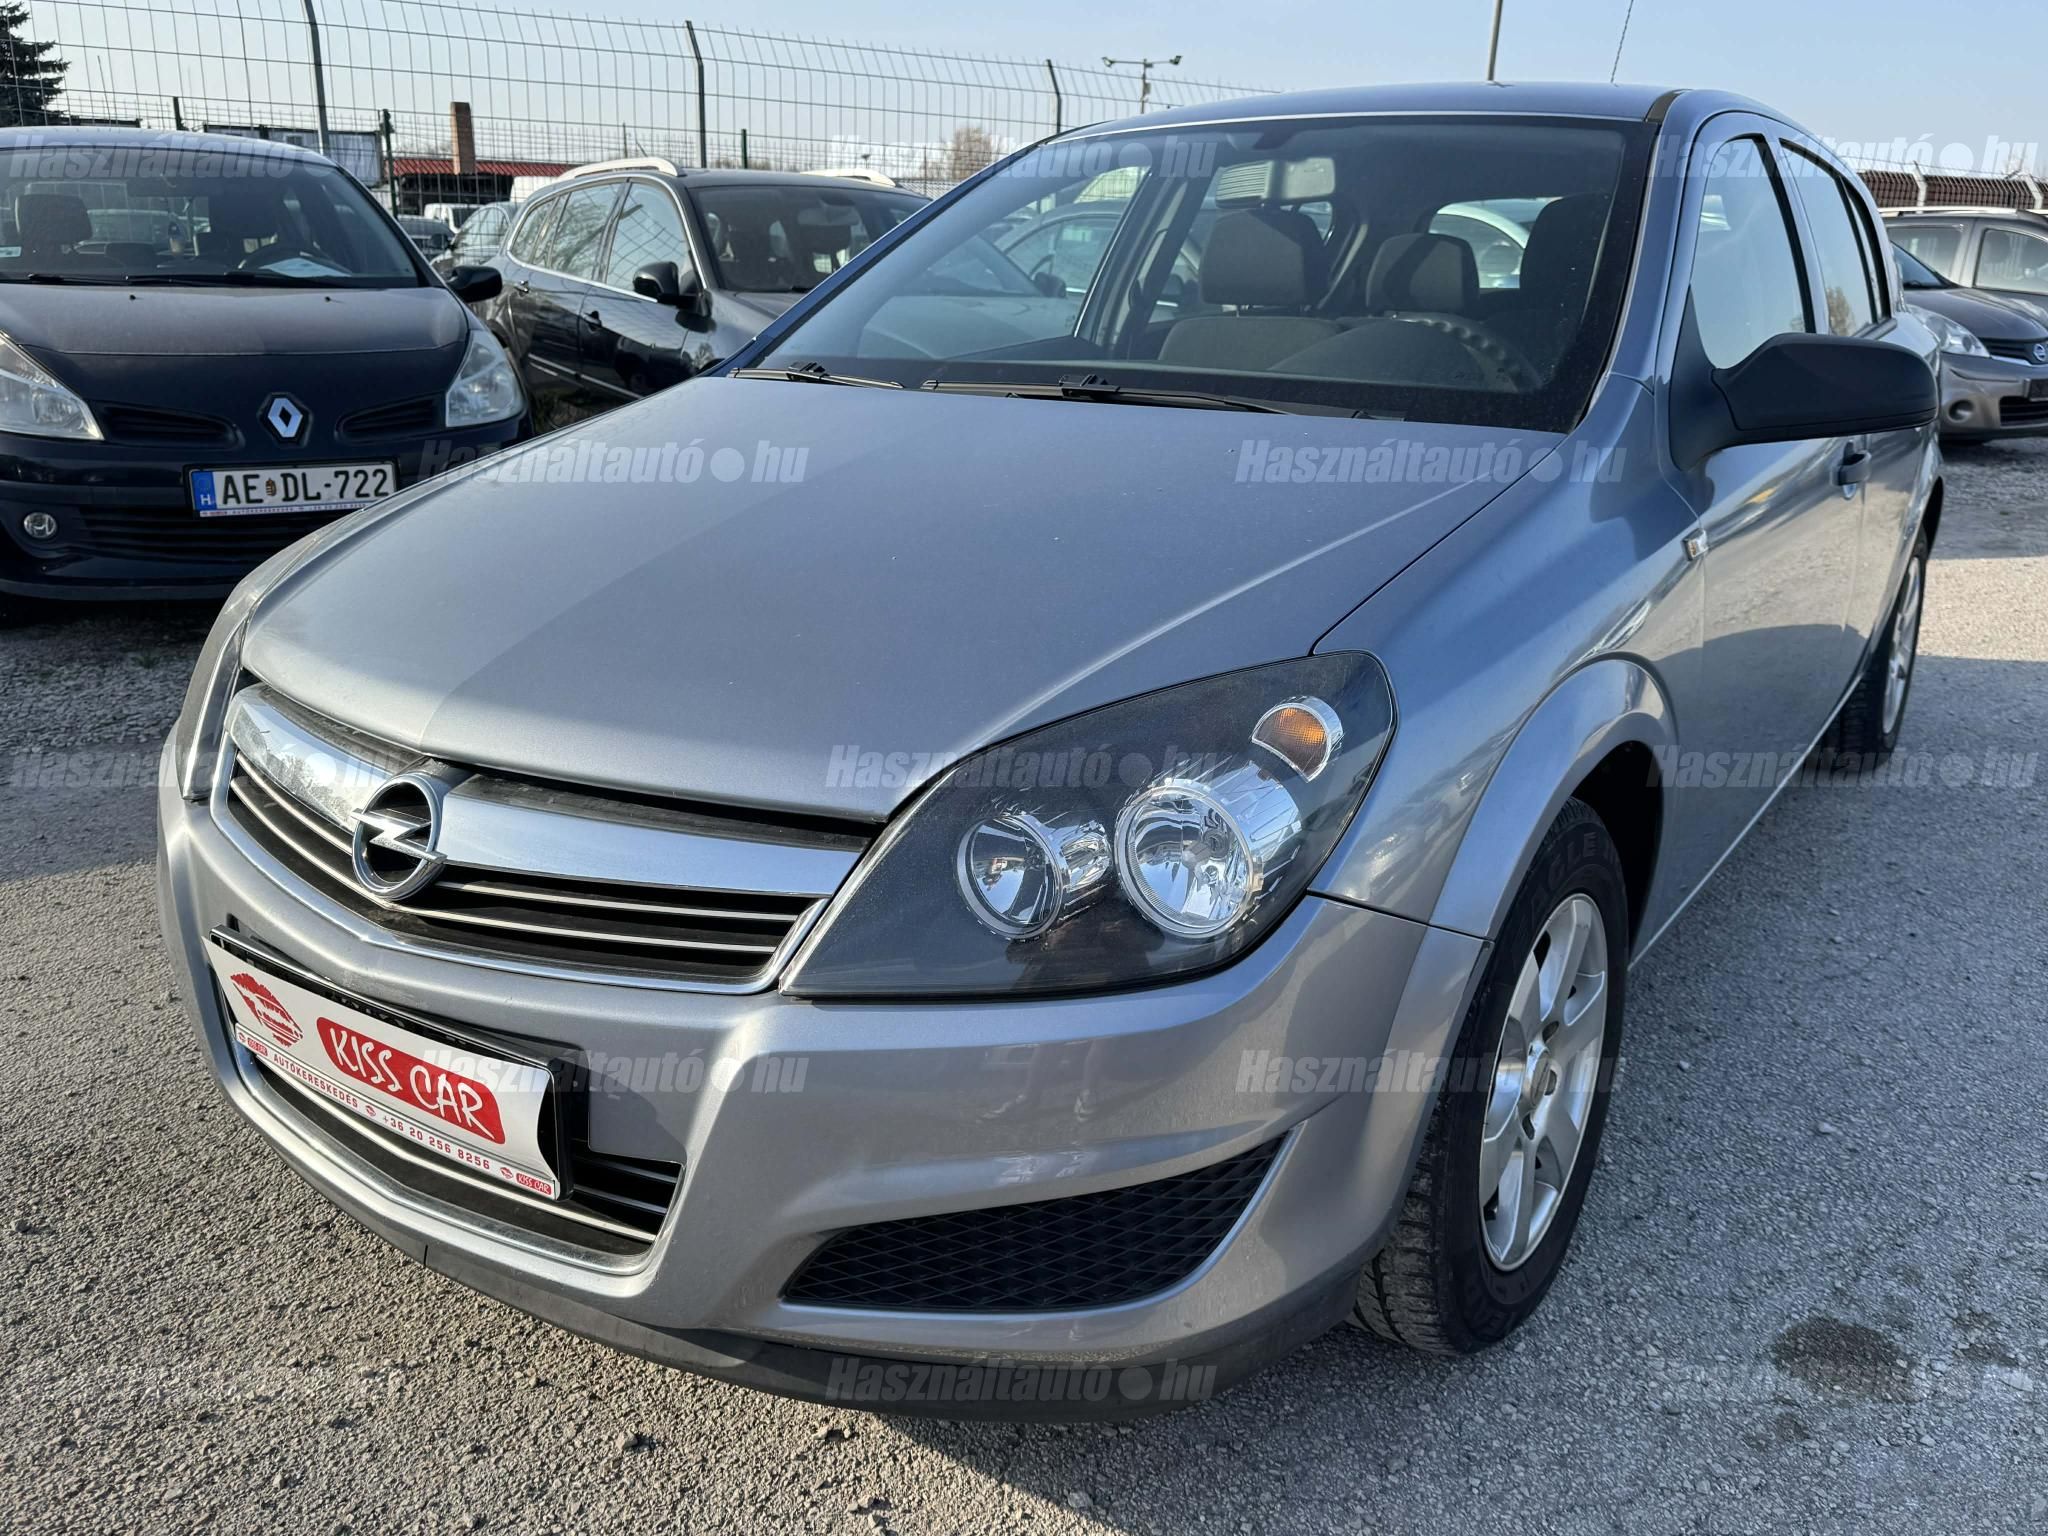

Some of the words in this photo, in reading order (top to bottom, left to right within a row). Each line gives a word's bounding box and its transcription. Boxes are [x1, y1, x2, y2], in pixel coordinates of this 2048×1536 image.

[200, 494, 211, 506] H
[222, 473, 263, 505] AE
[280, 468, 389, 502] DL-722
[330, 1028, 403, 1092] KISS
[410, 1065, 495, 1140] CAR
[383, 1115, 404, 1132] +36
[409, 1127, 423, 1141] 20
[429, 1136, 451, 1153] 256
[457, 1149, 490, 1170] 8256
[517, 1174, 533, 1187] KISS
[534, 1180, 550, 1194] CAR
